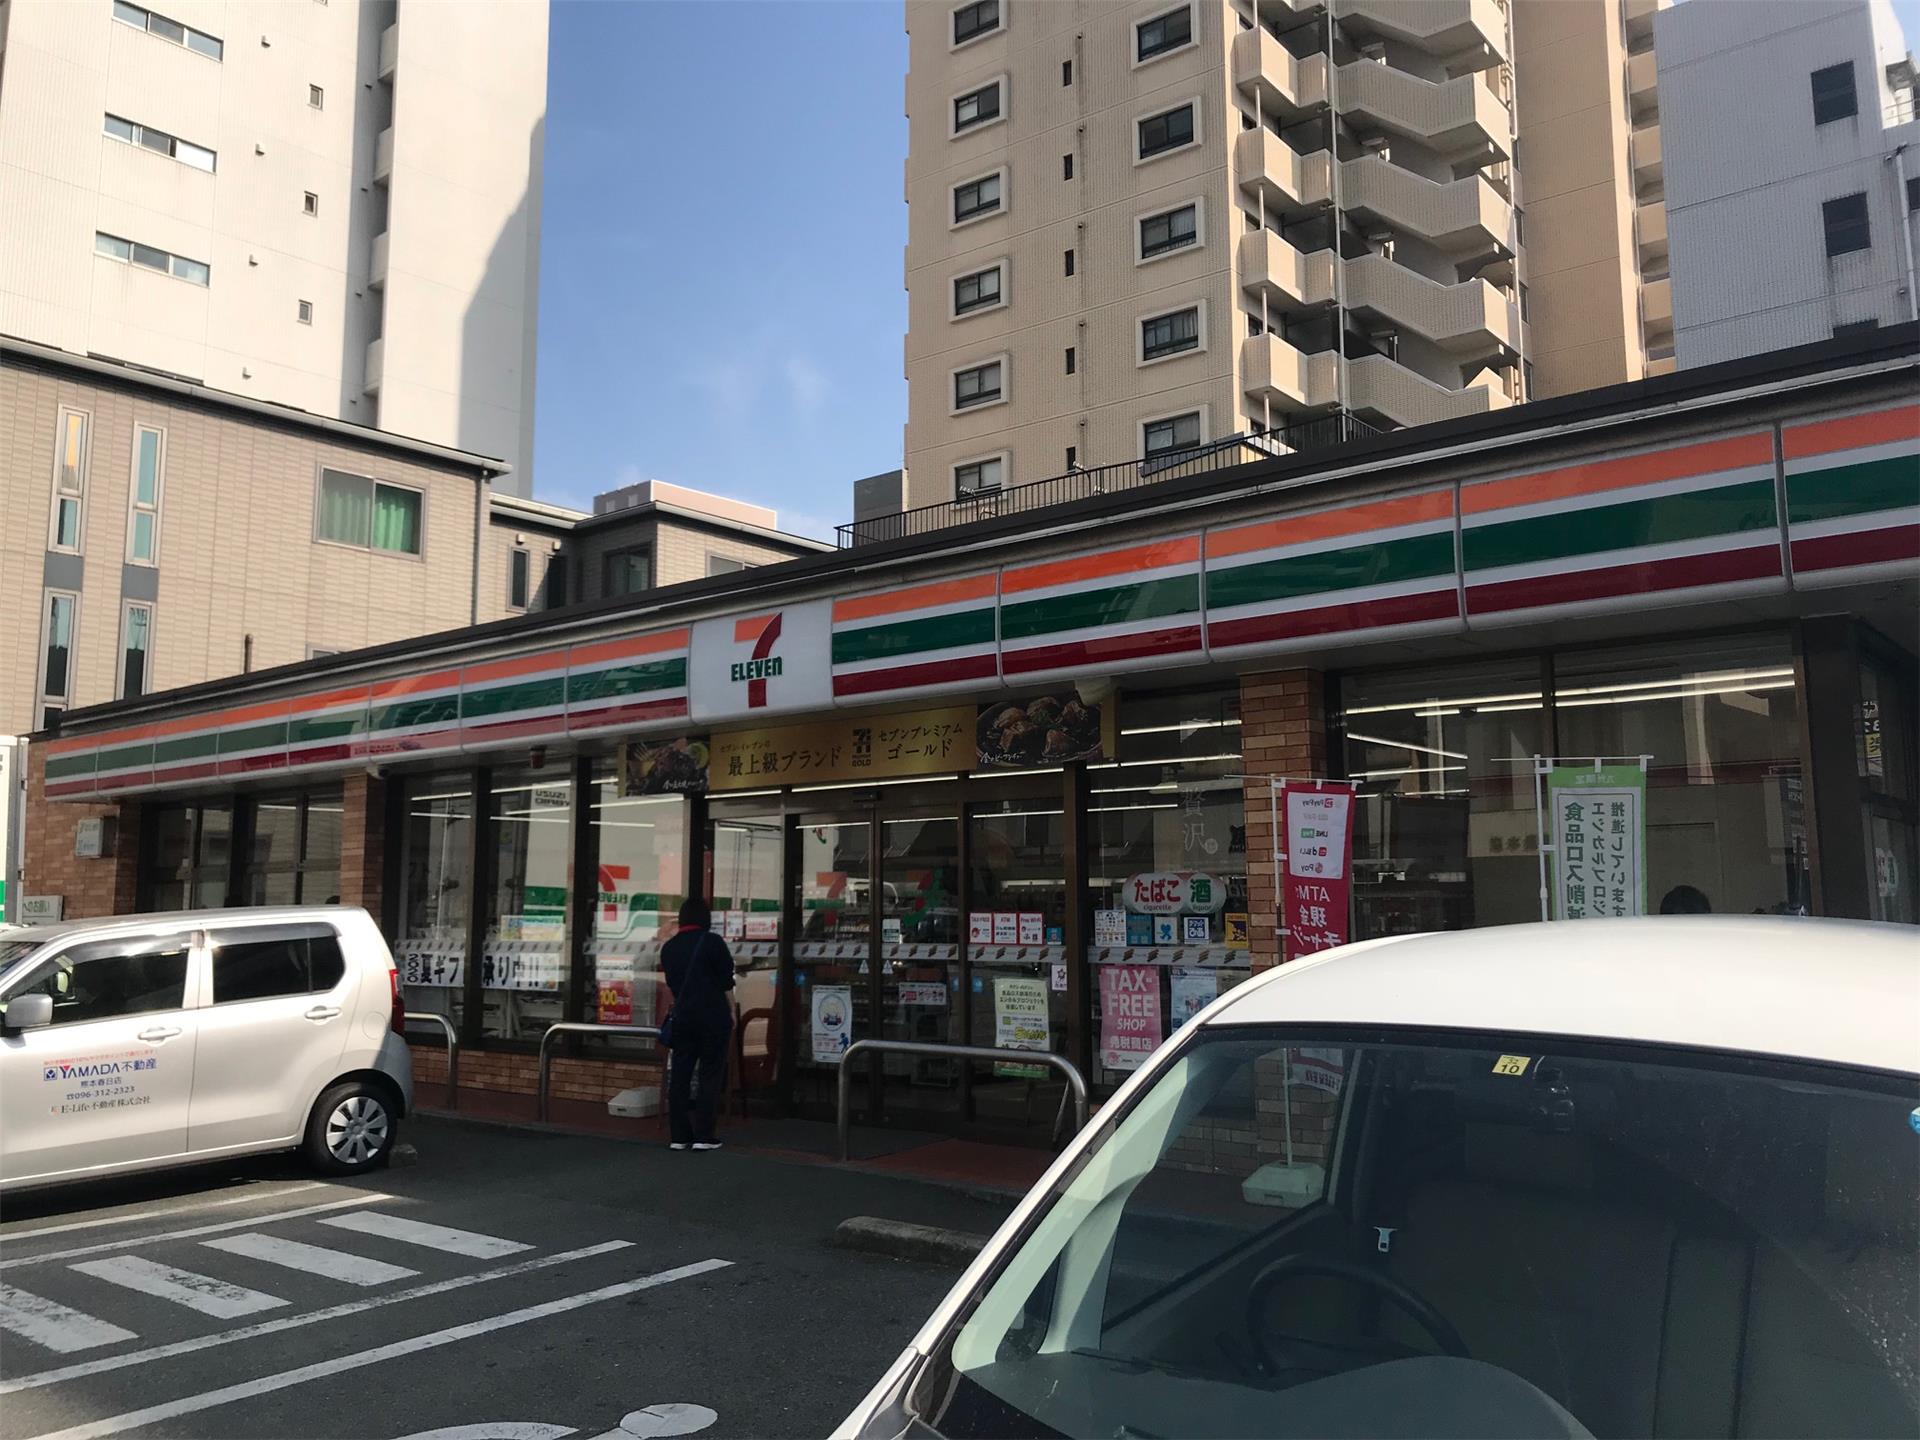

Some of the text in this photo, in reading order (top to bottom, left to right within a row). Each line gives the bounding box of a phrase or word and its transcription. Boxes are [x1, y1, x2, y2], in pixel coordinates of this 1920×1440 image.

[734, 612, 783, 708] 7
[727, 747, 843, 777] 最上級ブランド
[888, 739, 953, 761] ゴールド
[1134, 877, 1212, 903] たばこ 酒
[1107, 993, 1155, 1017] FREE
[1117, 1018, 1146, 1031] SHOP
[1501, 1063, 1520, 1074] 10
